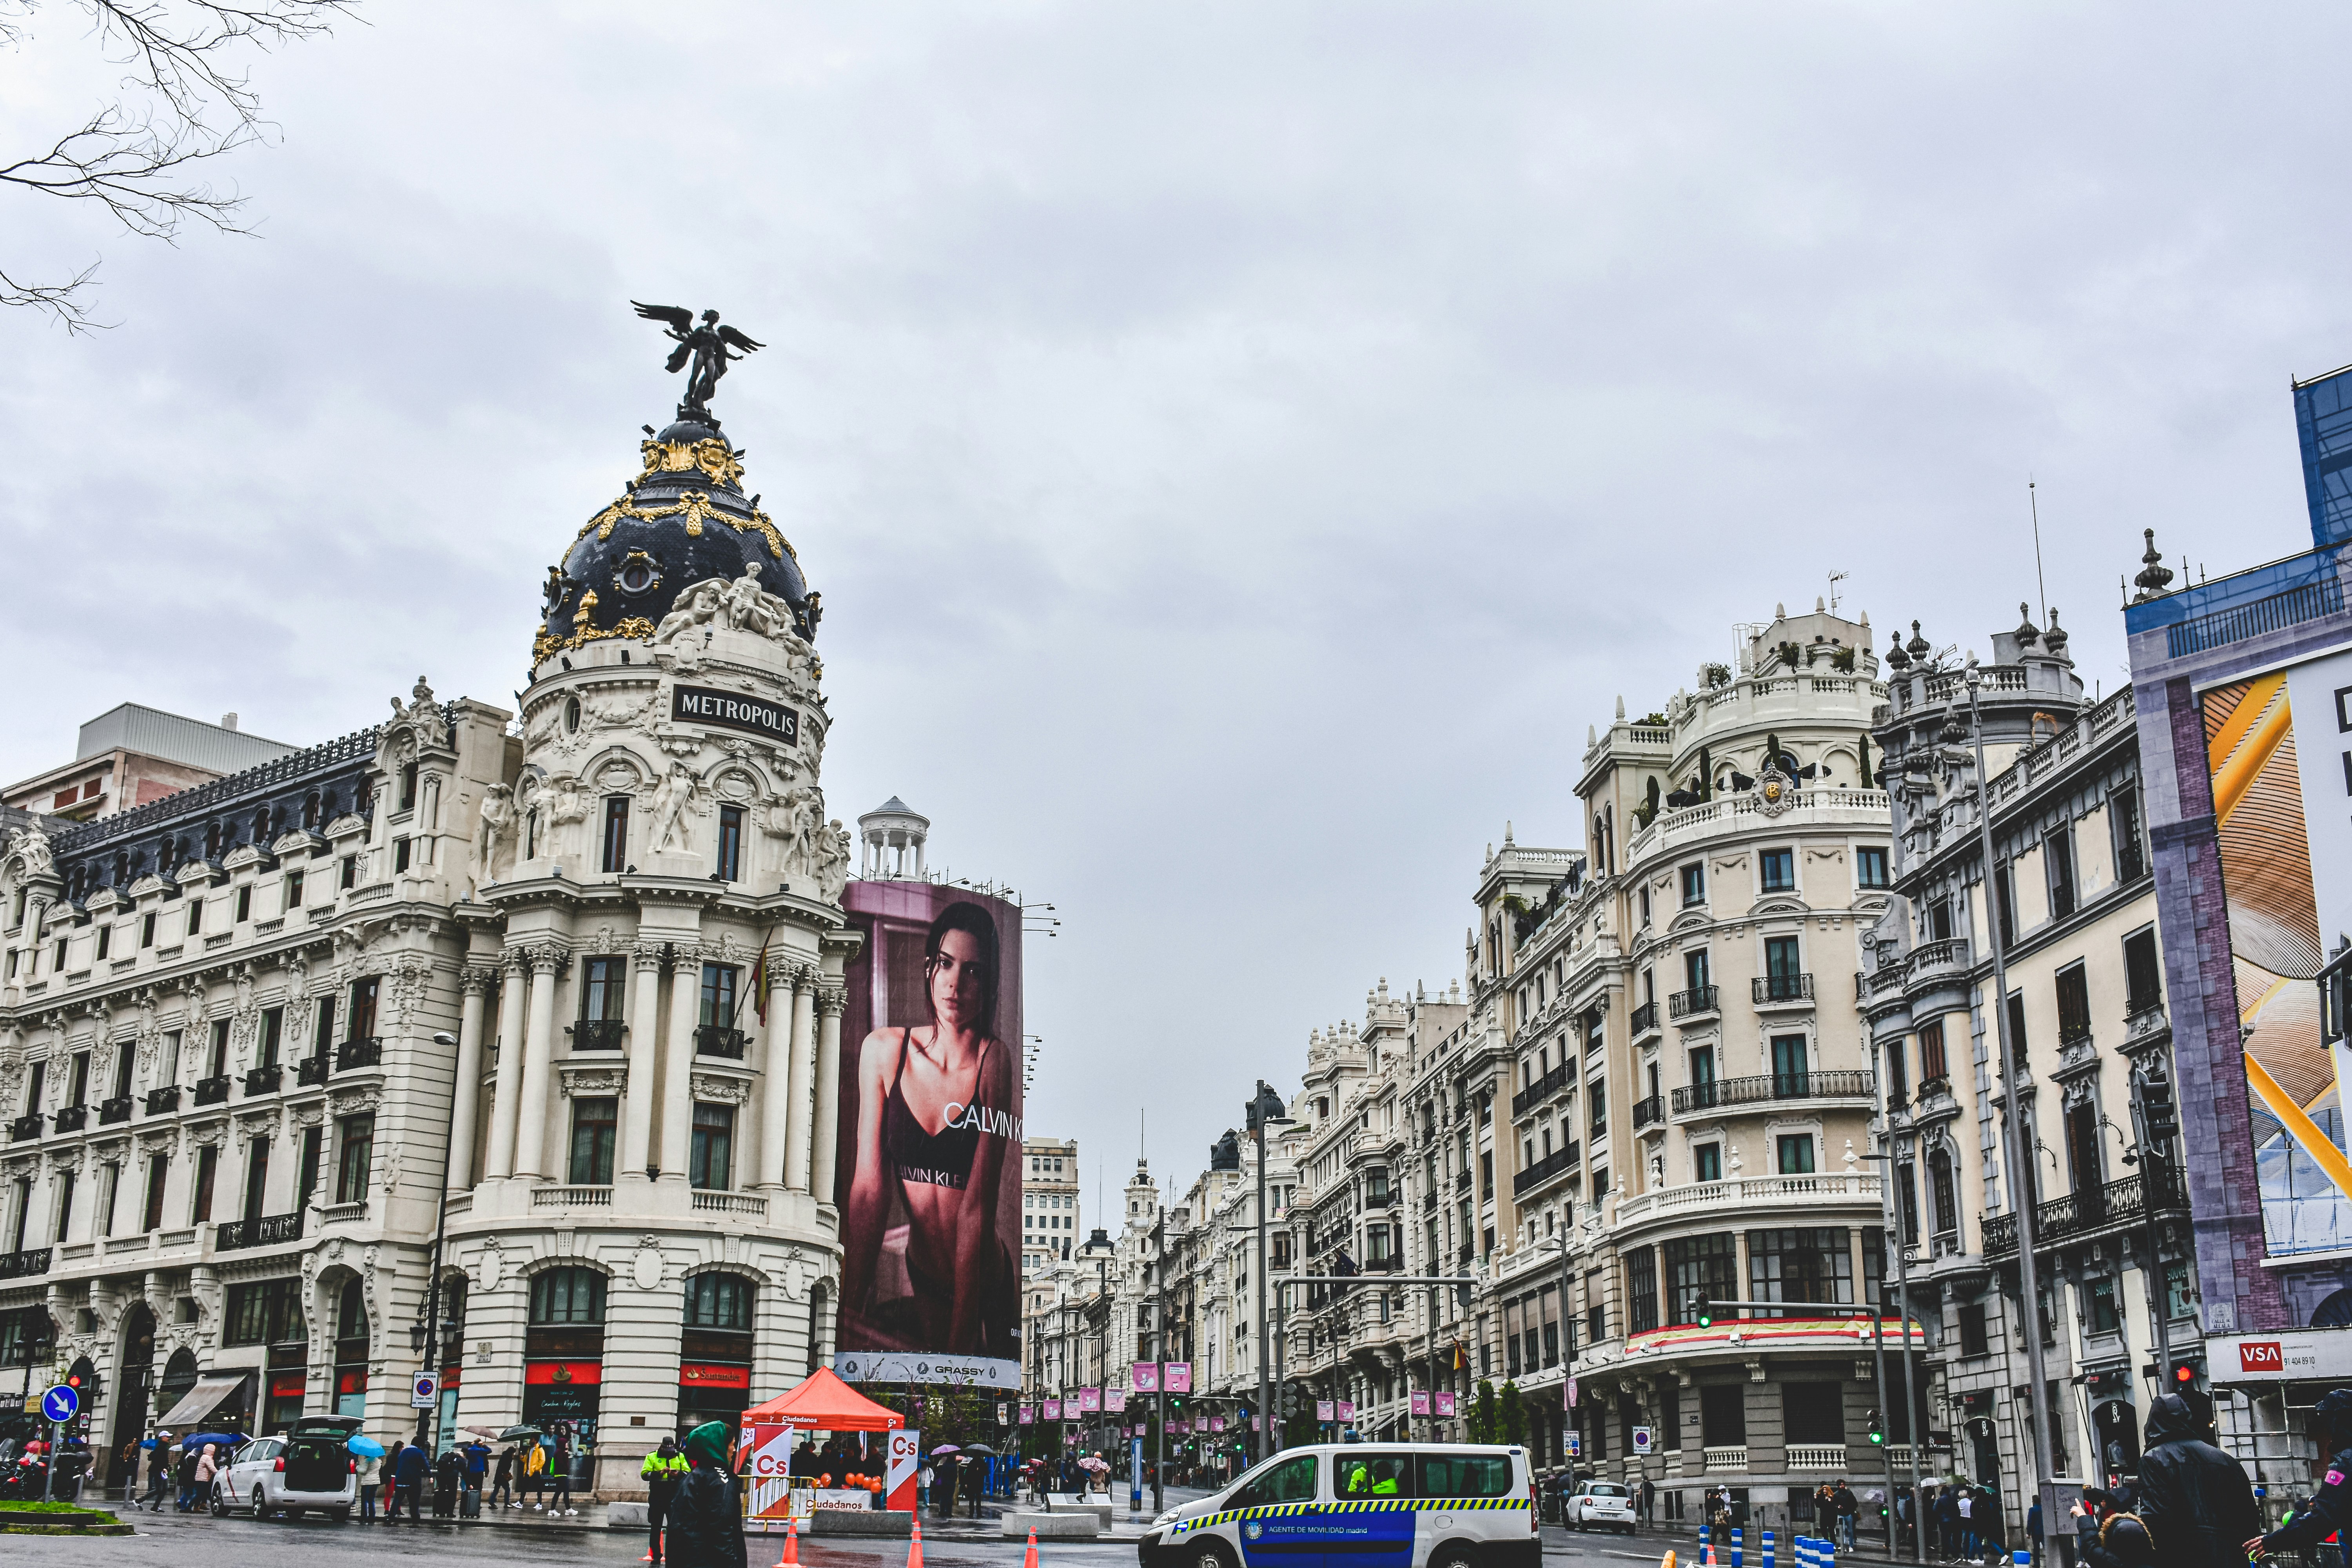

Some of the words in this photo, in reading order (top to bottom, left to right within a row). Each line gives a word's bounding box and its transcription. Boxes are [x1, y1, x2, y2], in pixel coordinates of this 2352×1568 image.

[682, 695, 794, 735] METROPOLIS
[944, 1102, 1012, 1140] CALVIN
[2243, 1347, 2279, 1361] VSA
[701, 1369, 741, 1381] Santander
[935, 1366, 984, 1376] GRASSY
[564, 1399, 581, 1410] Reglas
[893, 1436, 916, 1455] Cs
[757, 1455, 786, 1475] Cs
[806, 1499, 862, 1509] Cudadanos
